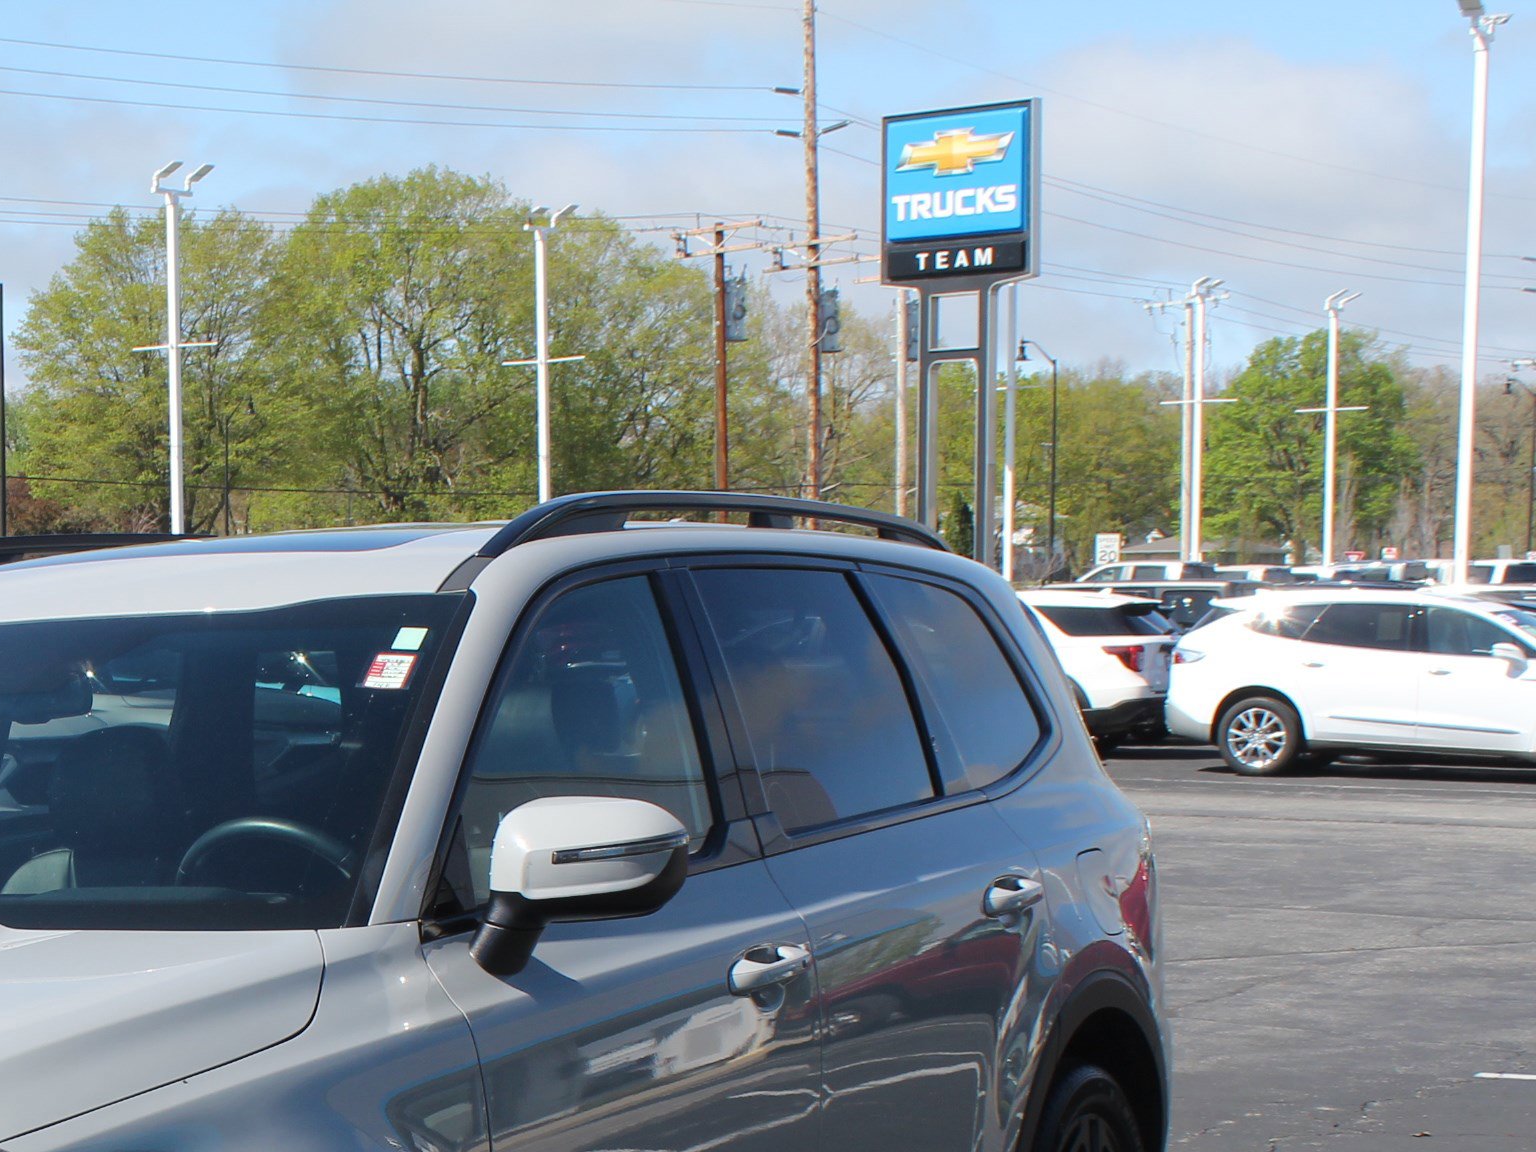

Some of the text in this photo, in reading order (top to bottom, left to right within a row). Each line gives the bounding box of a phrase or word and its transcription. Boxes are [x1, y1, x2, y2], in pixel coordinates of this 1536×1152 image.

[891, 184, 1017, 222] TRUCKS
[916, 247, 994, 270] TEAM
[1099, 550, 1117, 562] 20
